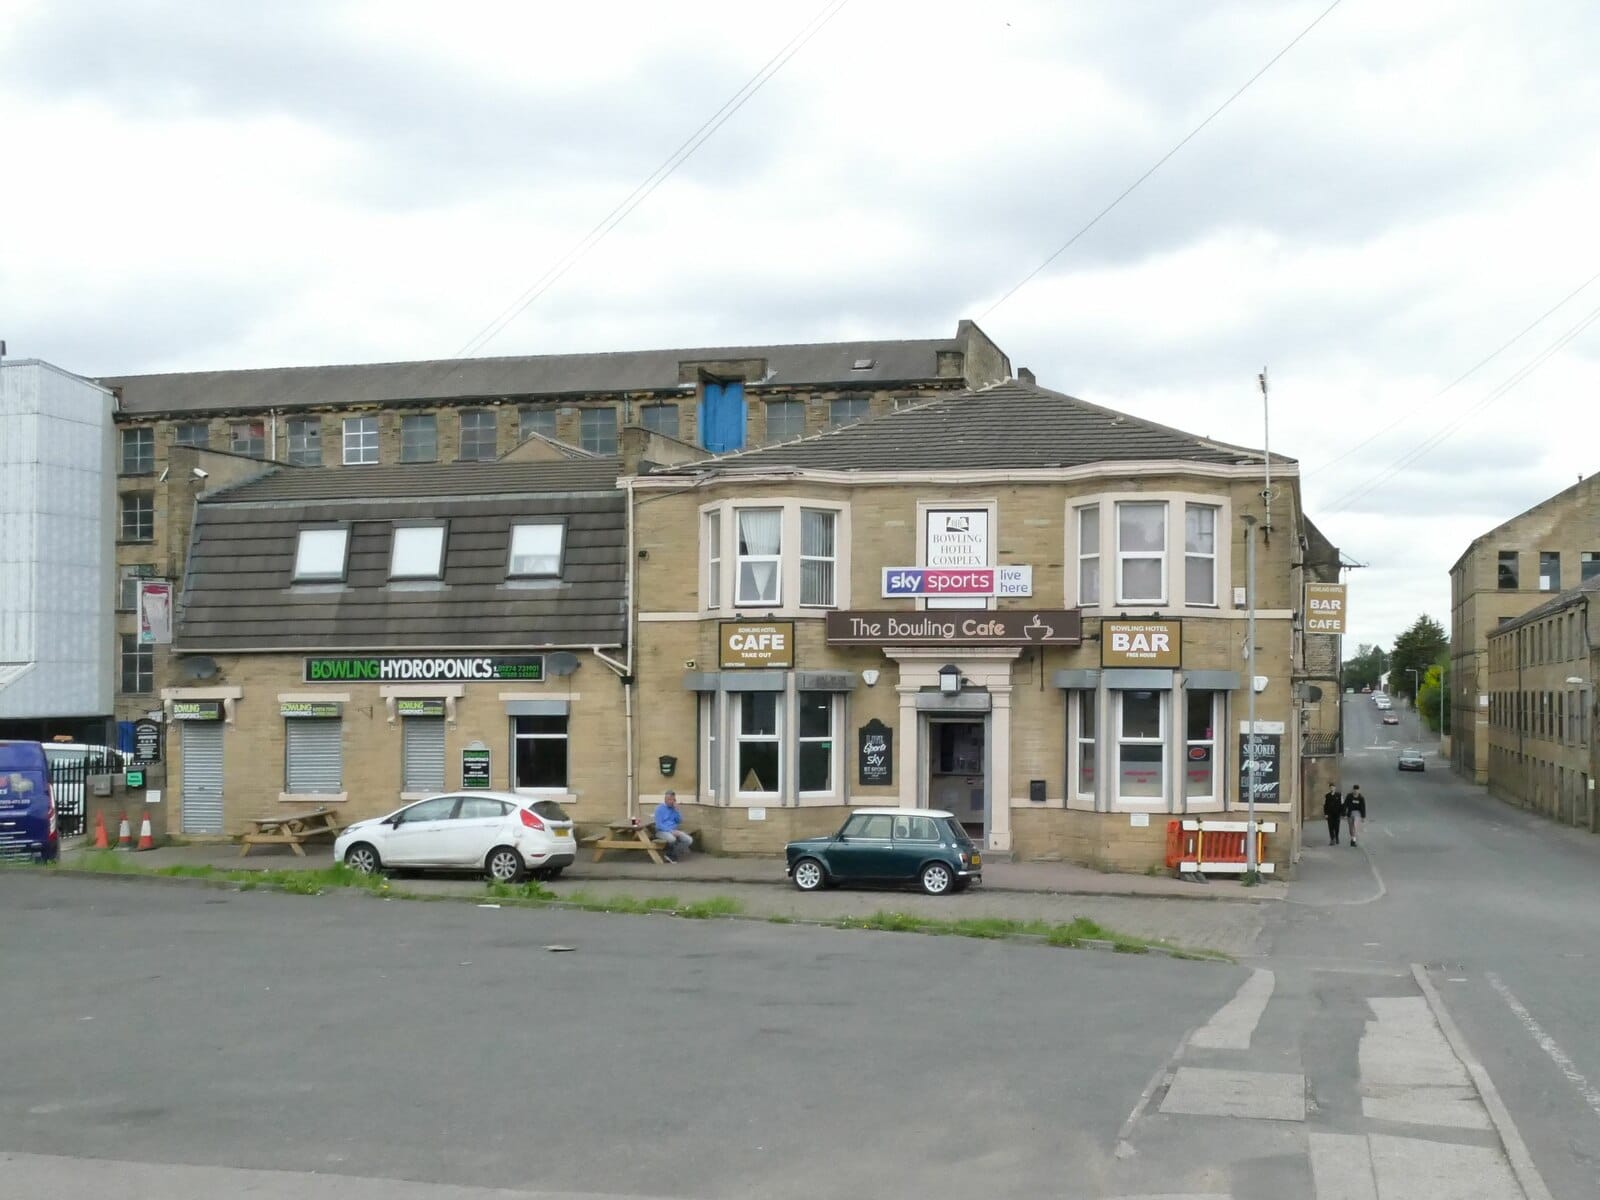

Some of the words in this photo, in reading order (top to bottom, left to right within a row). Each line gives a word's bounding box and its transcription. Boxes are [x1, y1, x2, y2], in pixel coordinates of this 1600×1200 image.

[933, 534, 982, 543] BOWLING
[941, 545, 972, 554] HOTEL
[932, 555, 981, 565] COMPLEX
[1000, 569, 1021, 580] live
[891, 572, 921, 591] sky
[928, 573, 989, 591] sports
[1000, 583, 1028, 592] here
[1310, 599, 1341, 610] BAR
[850, 618, 881, 636] The
[888, 618, 955, 638] Bowling
[962, 619, 1005, 636] Cafe
[1309, 619, 1341, 629] CAFE
[729, 634, 785, 651] CAFE
[1112, 633, 1170, 652] BAR
[1243, 744, 1275, 754] SOOKER
